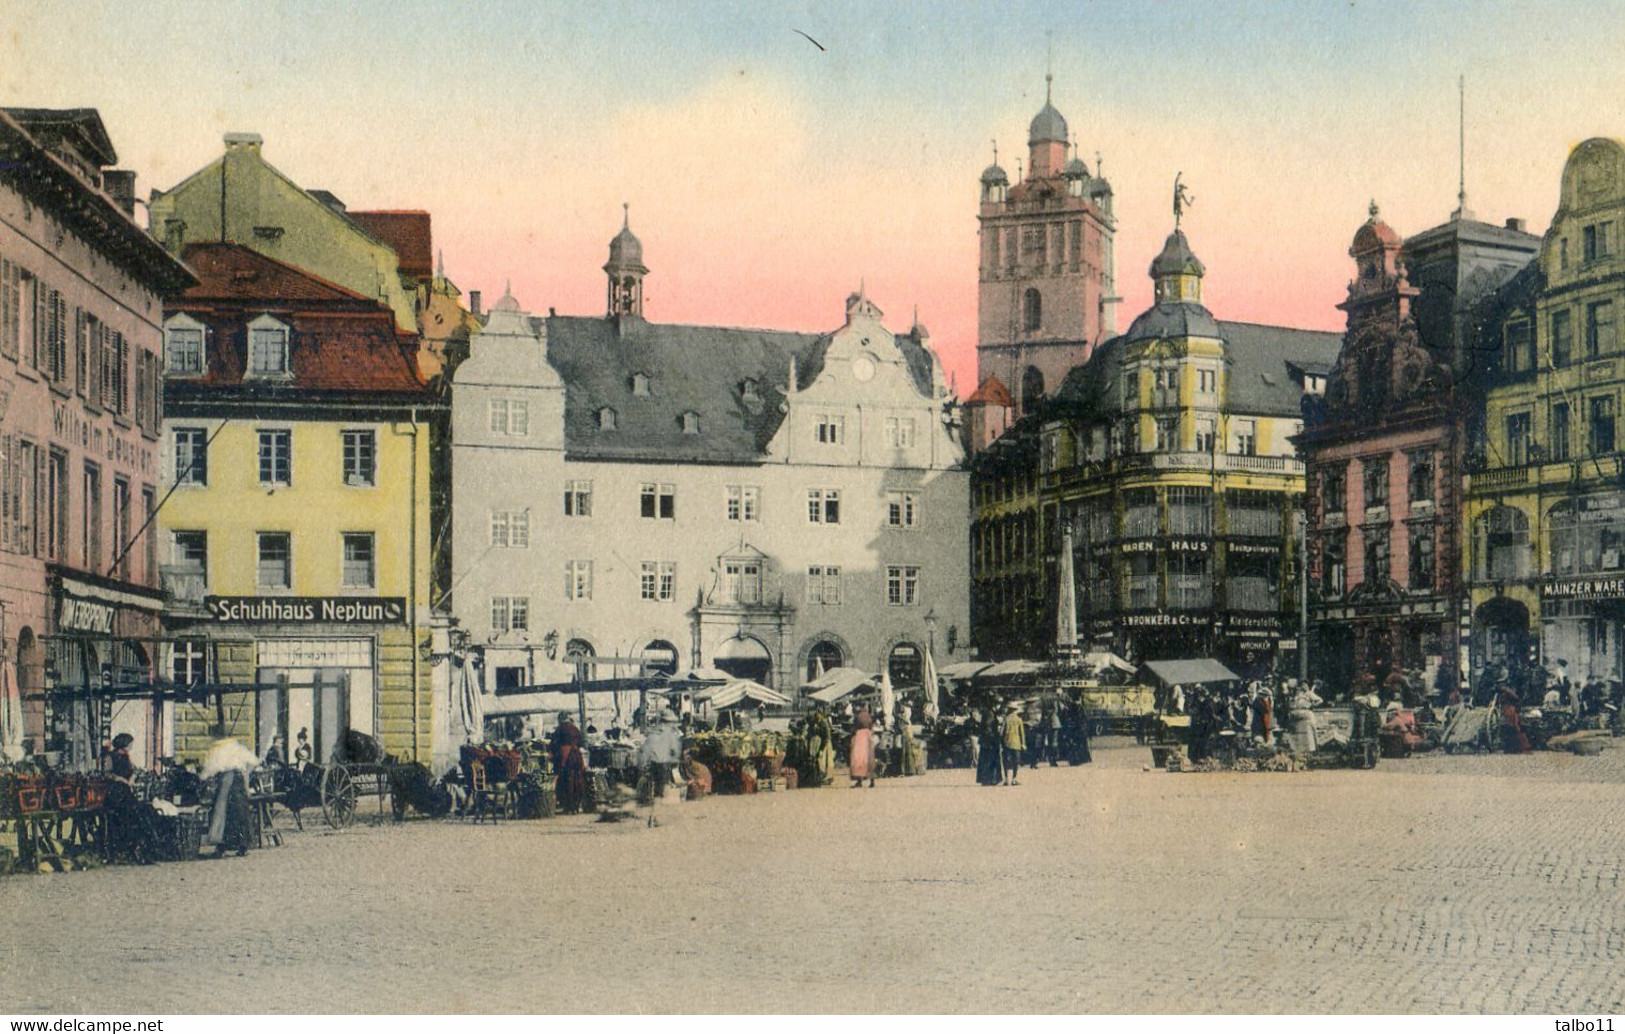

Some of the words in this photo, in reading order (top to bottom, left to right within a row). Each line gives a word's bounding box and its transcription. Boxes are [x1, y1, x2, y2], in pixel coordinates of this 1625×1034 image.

[52, 400, 103, 454] Wilhelm
[1172, 541, 1208, 551] HAUS
[1544, 582, 1591, 595] MAINZER
[218, 600, 314, 621] Schuhhaus
[322, 600, 383, 622] Neptun
